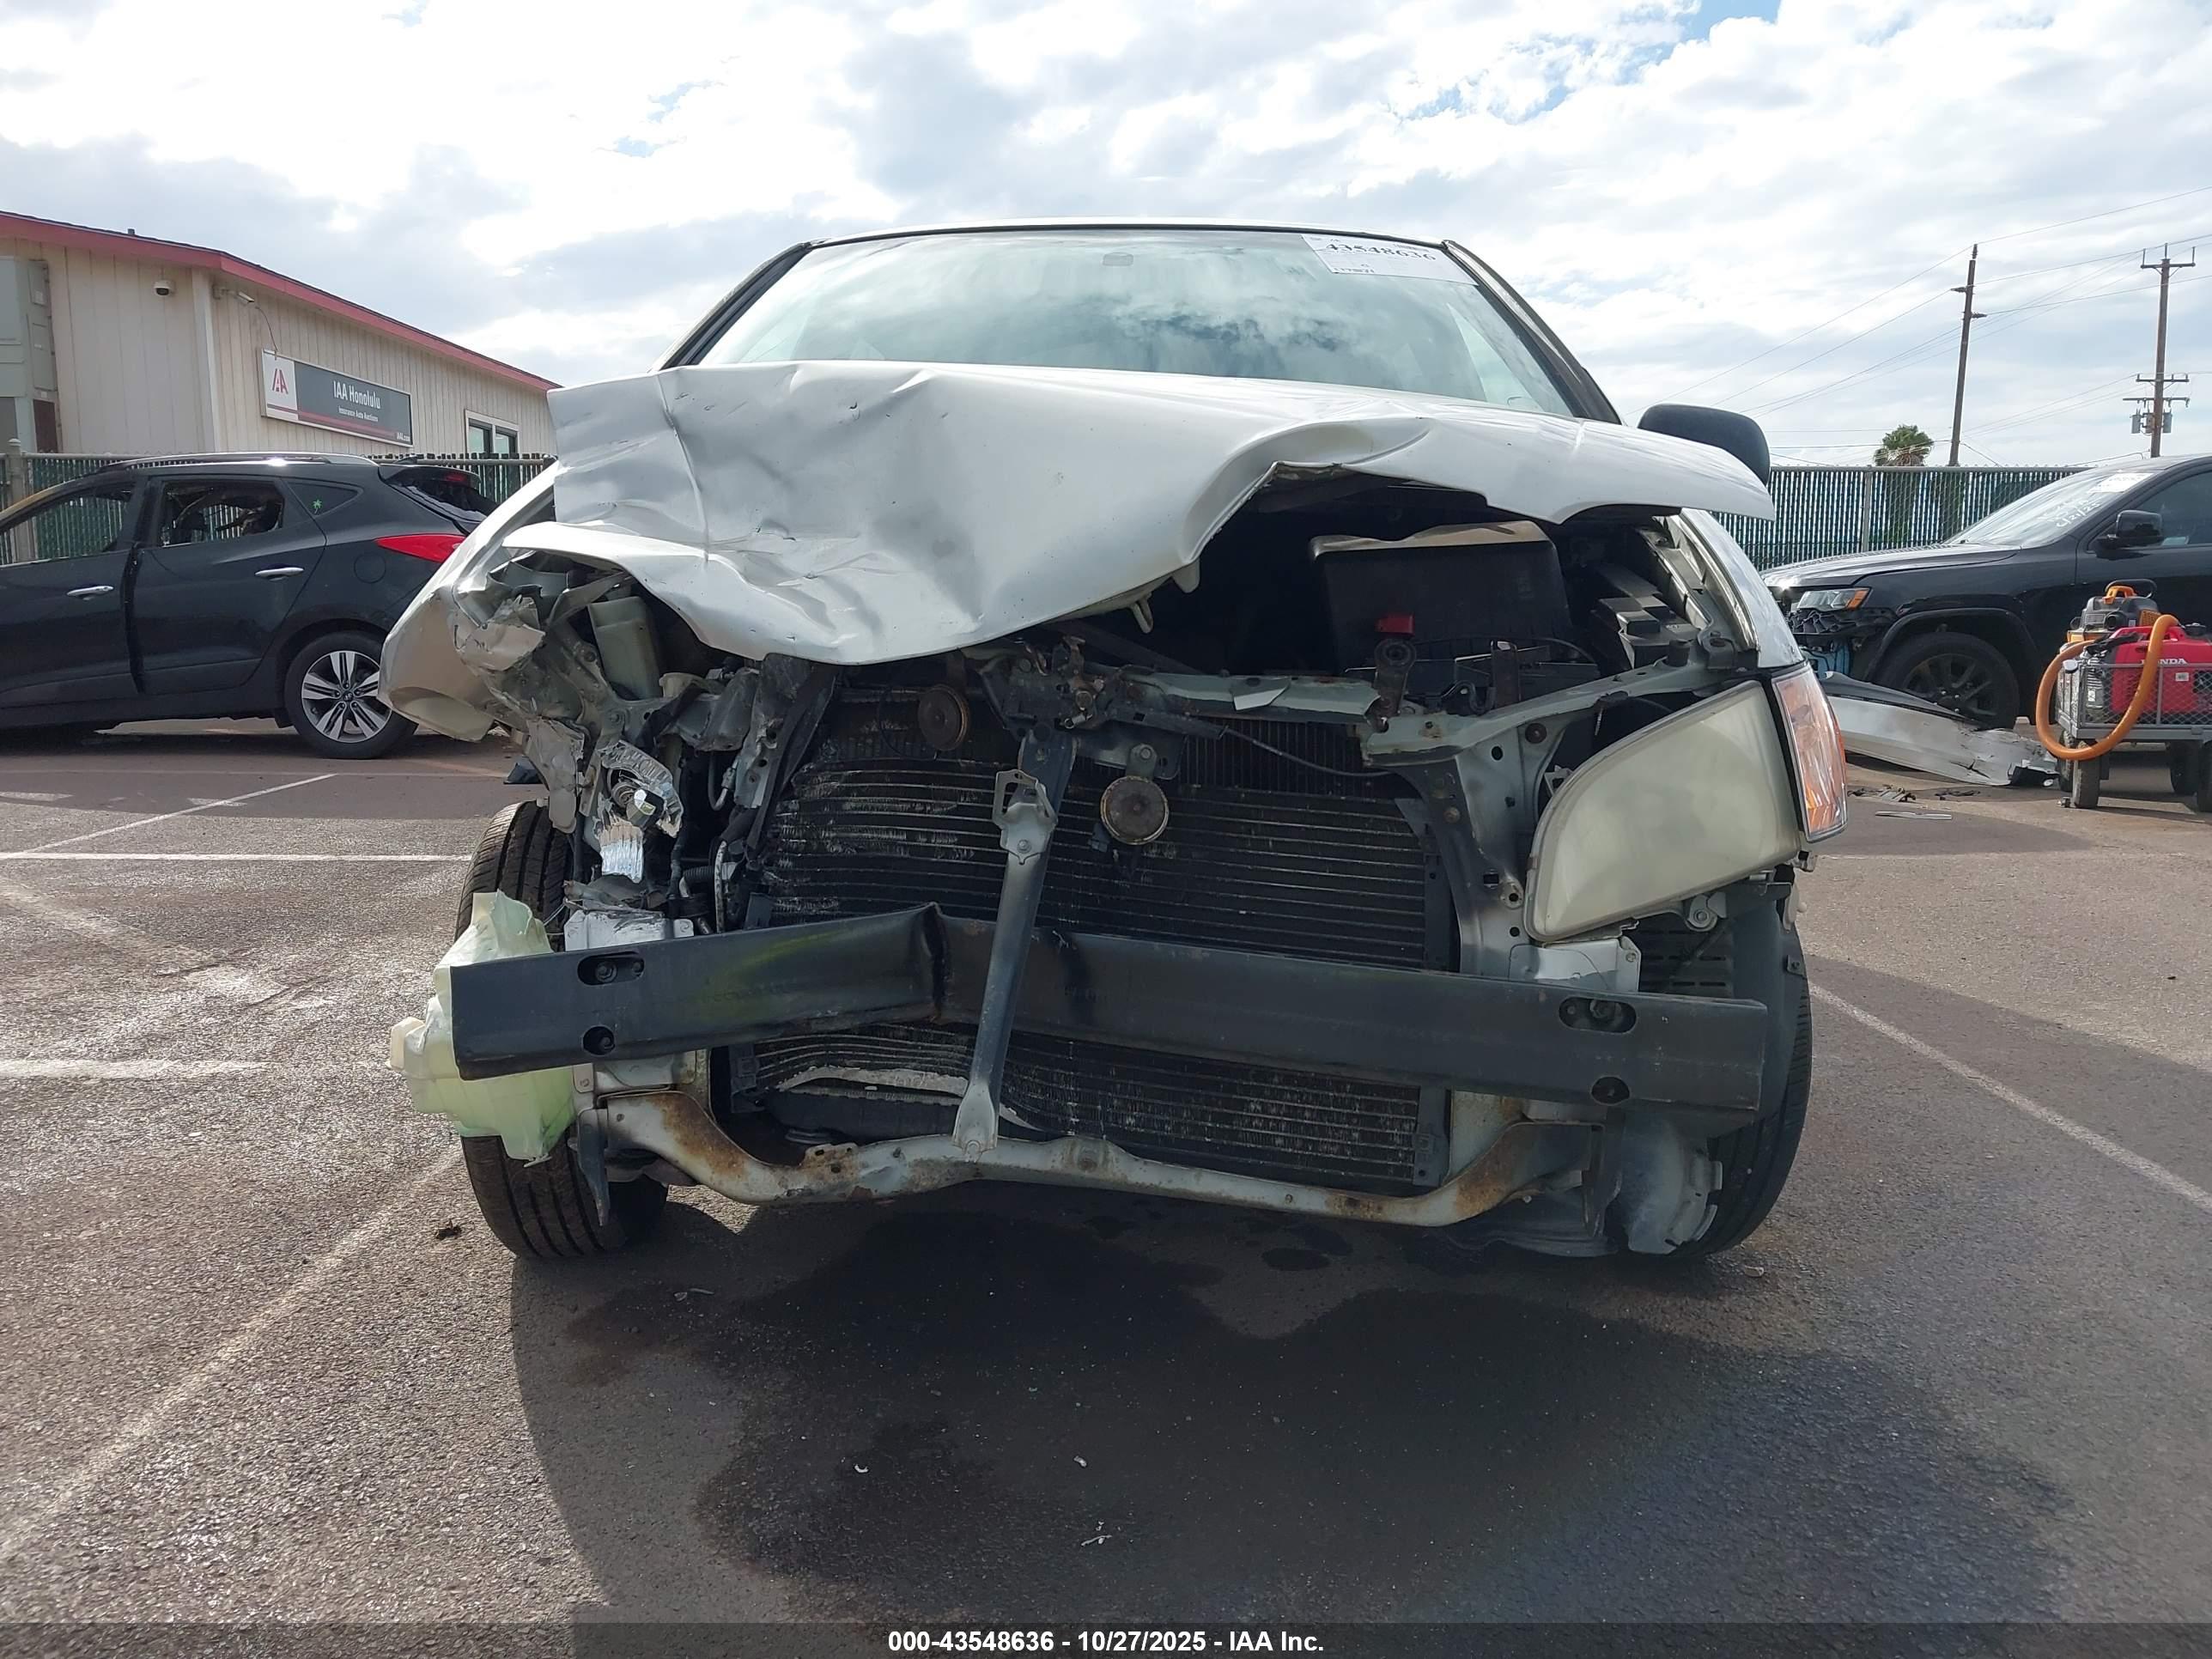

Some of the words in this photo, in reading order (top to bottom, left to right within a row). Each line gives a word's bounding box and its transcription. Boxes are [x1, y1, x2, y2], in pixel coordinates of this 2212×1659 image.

[1326, 243, 1437, 260] 43548636
[333, 380, 348, 401] IAA
[349, 385, 381, 410] Honolulu
